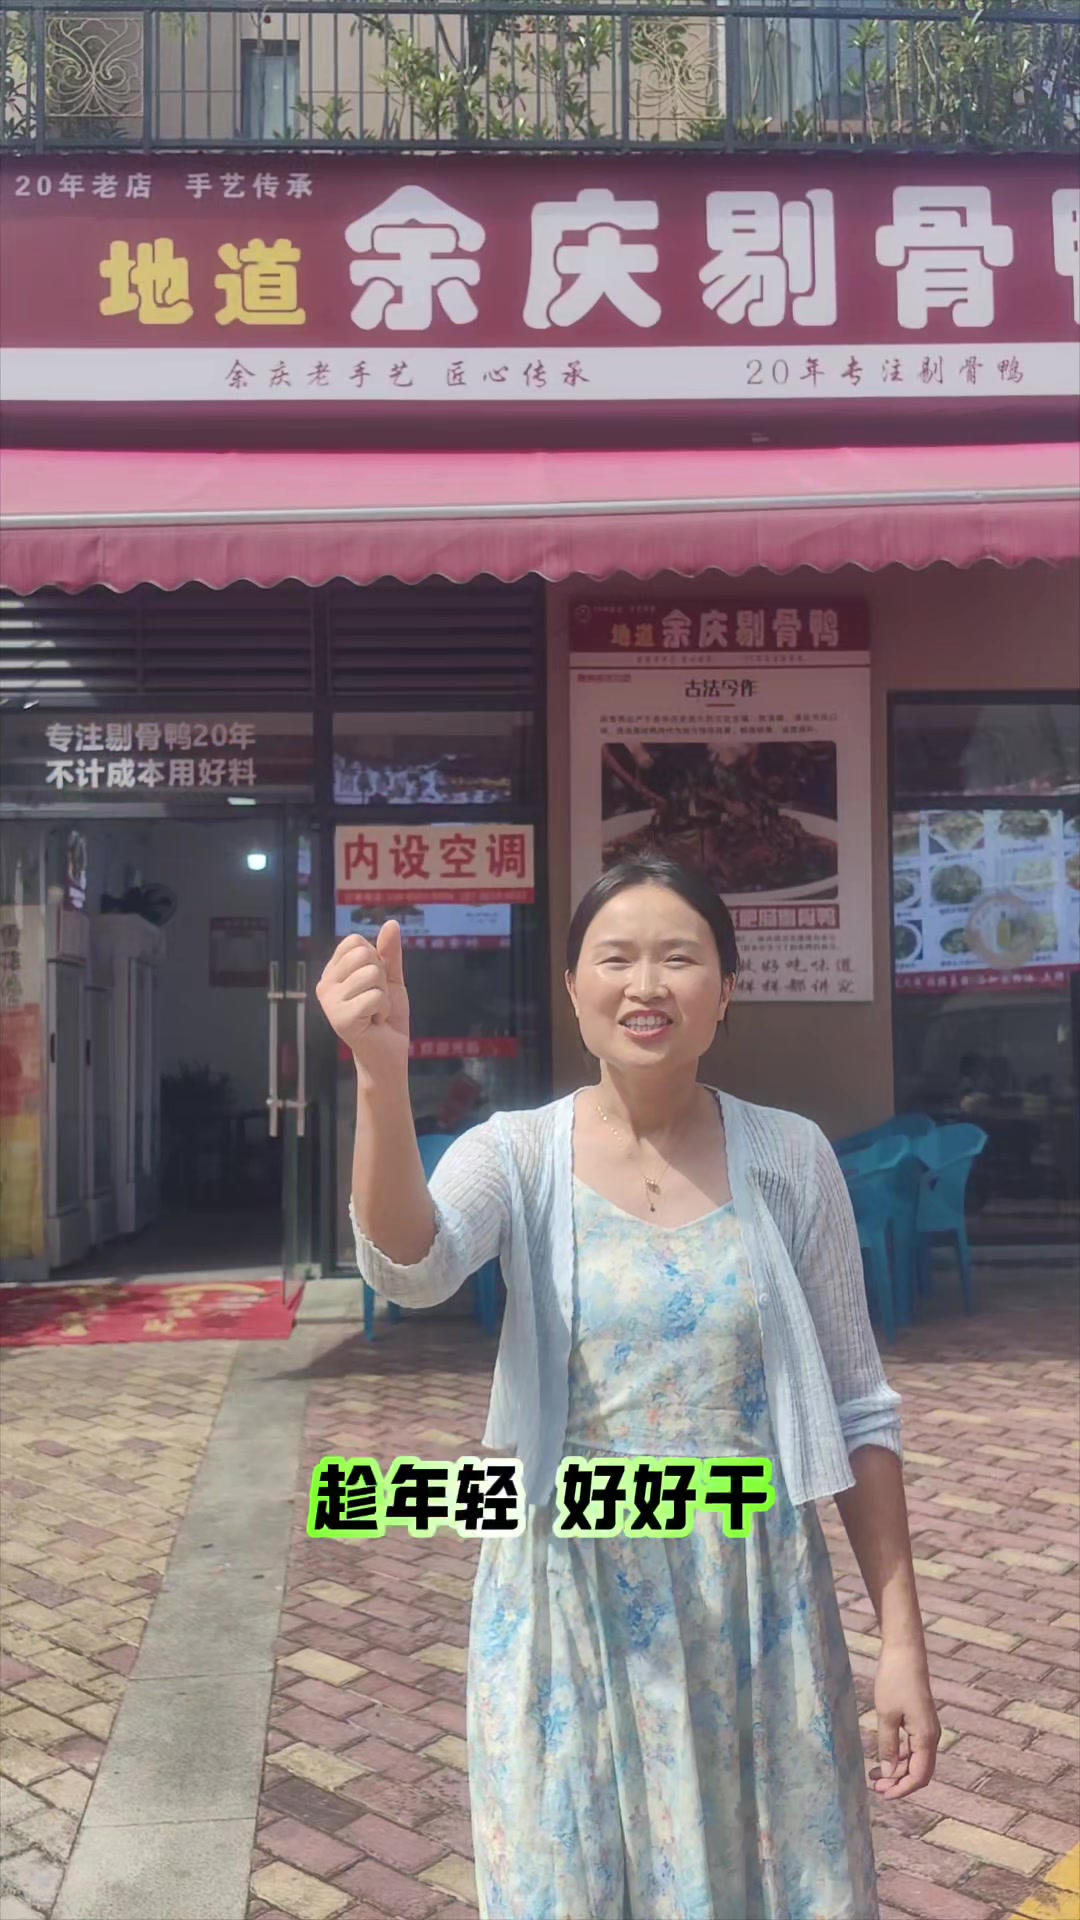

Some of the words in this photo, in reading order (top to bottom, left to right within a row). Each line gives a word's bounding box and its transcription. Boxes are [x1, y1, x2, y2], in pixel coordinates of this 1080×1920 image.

[15, 173, 153, 200] 20年老店
[186, 172, 314, 199] 手艺传承
[99, 237, 306, 326] 地道
[344, 185, 1080, 331] 余庆剔骨
[224, 359, 414, 388] 余庆老手艺
[445, 360, 591, 388] 匠心传承
[746, 357, 1026, 387] 20年专注剔骨鸭
[661, 608, 839, 649] 余庆剔骨鸭
[684, 678, 758, 699] 古法今作
[45, 722, 257, 753] 专注剔骨鸭20年
[45, 757, 257, 790] 不计成本用好料
[344, 832, 527, 880] 内设空调
